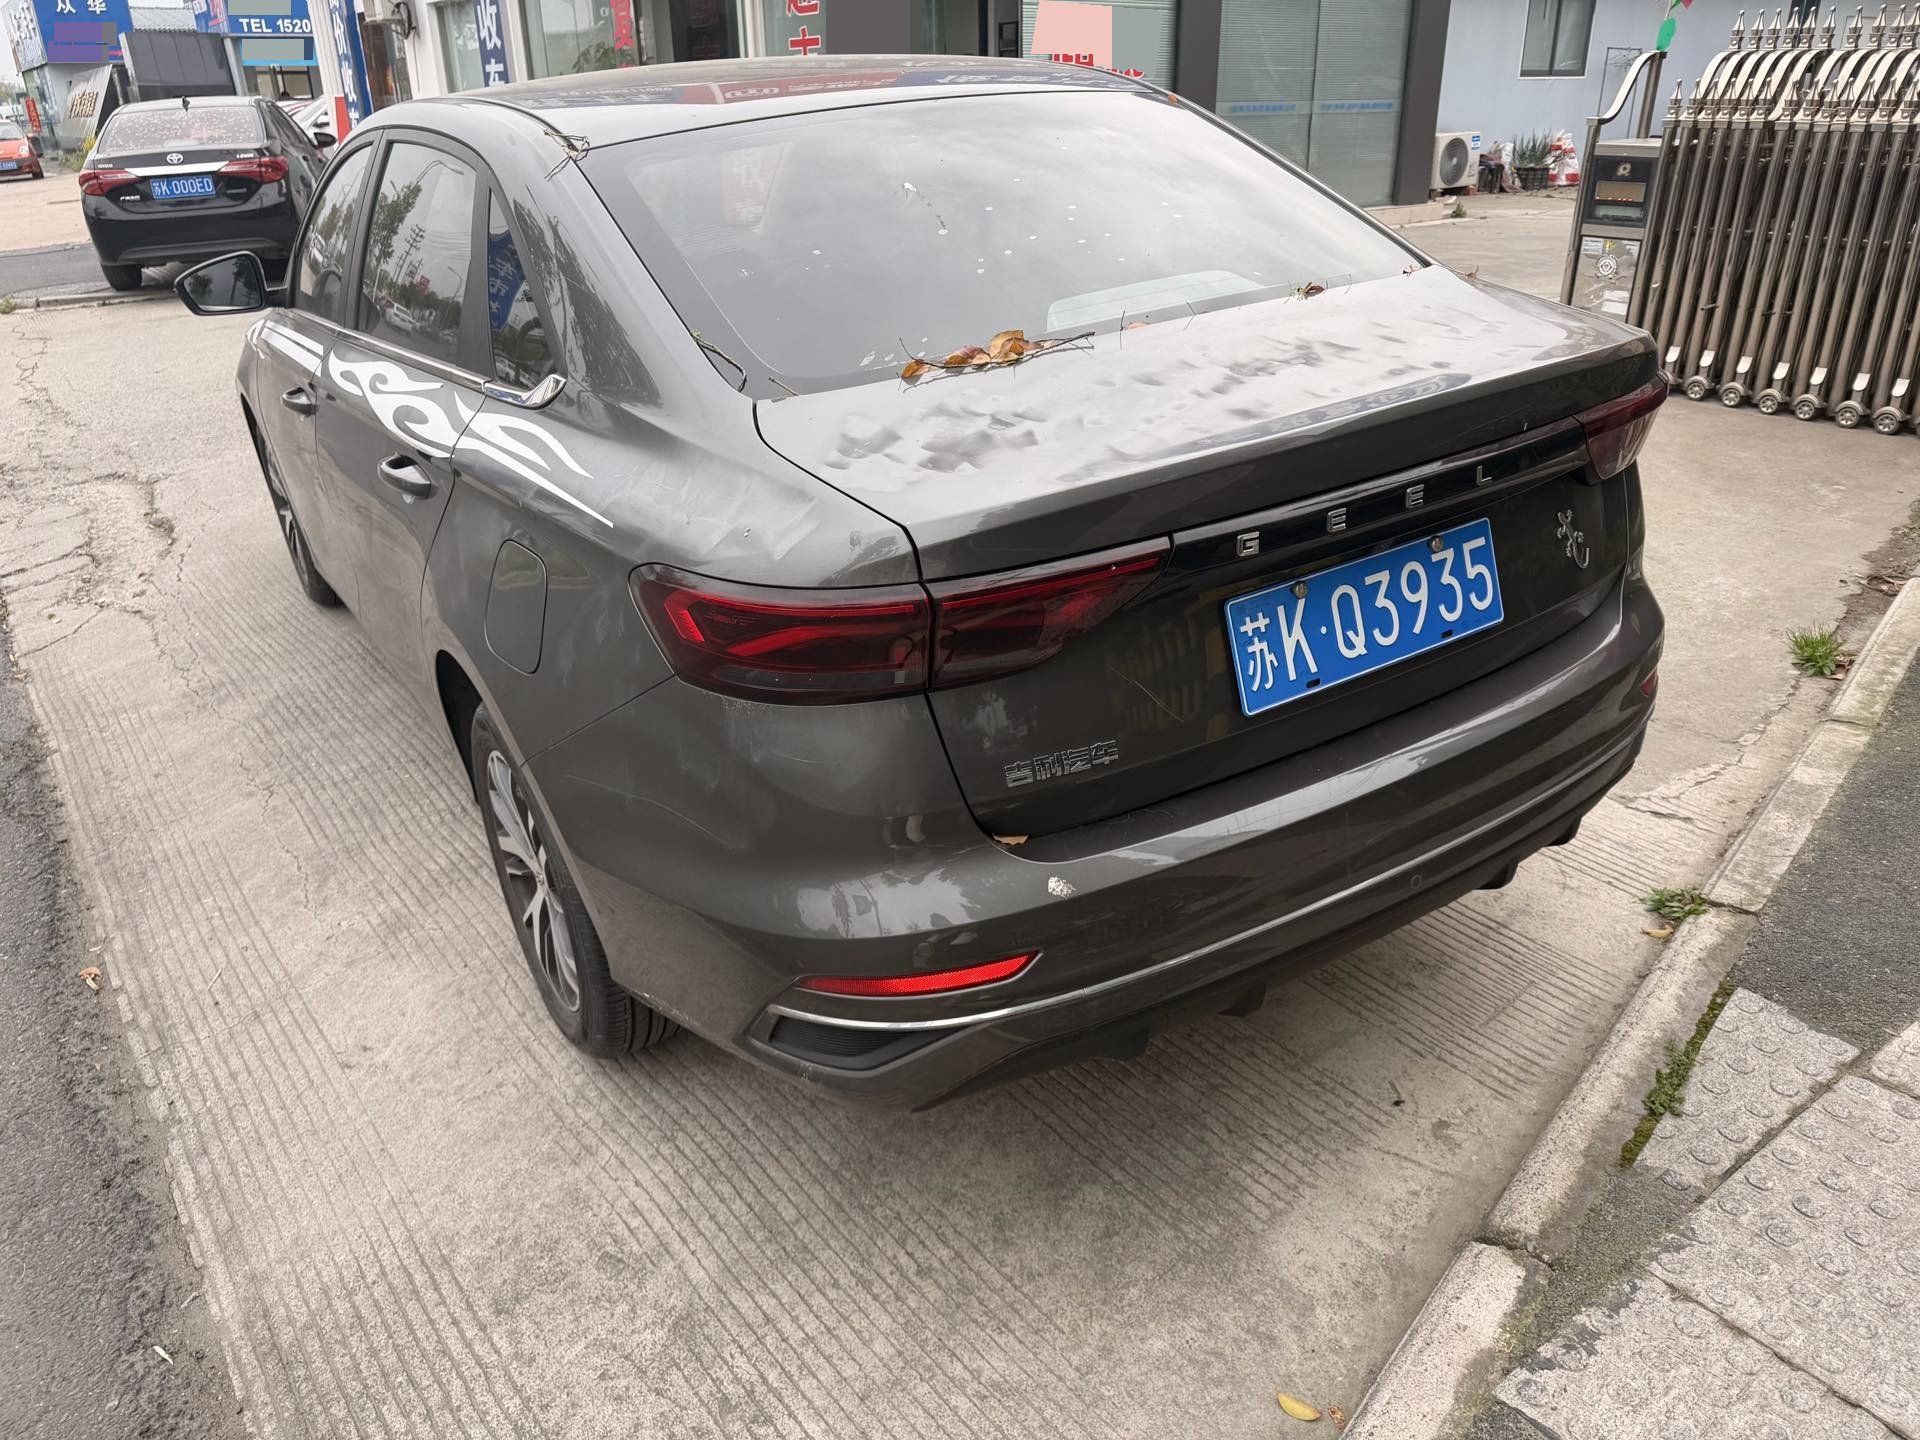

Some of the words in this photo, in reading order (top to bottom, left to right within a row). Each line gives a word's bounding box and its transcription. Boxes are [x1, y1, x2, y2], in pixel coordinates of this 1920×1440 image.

[239, 18, 273, 33] TEL
[276, 18, 312, 33] 1520
[1240, 536, 1495, 692] 苏K·Q3935
[1004, 739, 1119, 788] 吉利汽车
